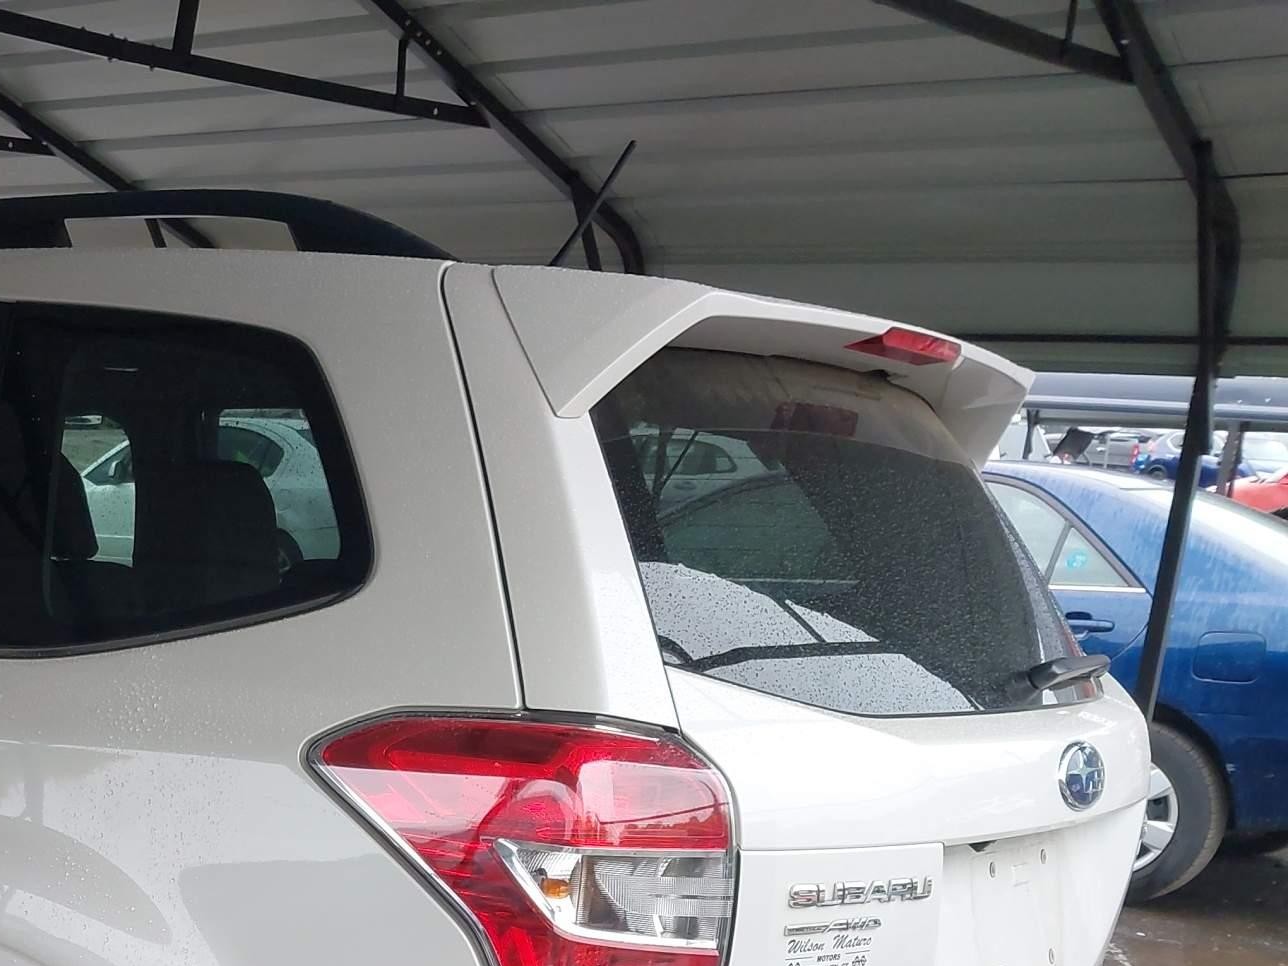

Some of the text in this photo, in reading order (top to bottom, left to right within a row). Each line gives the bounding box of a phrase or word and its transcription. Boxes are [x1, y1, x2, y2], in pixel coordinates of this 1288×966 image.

[788, 876, 933, 910] SUBARU
[787, 939, 825, 954] Wilson
[816, 953, 841, 962] MOTORS
